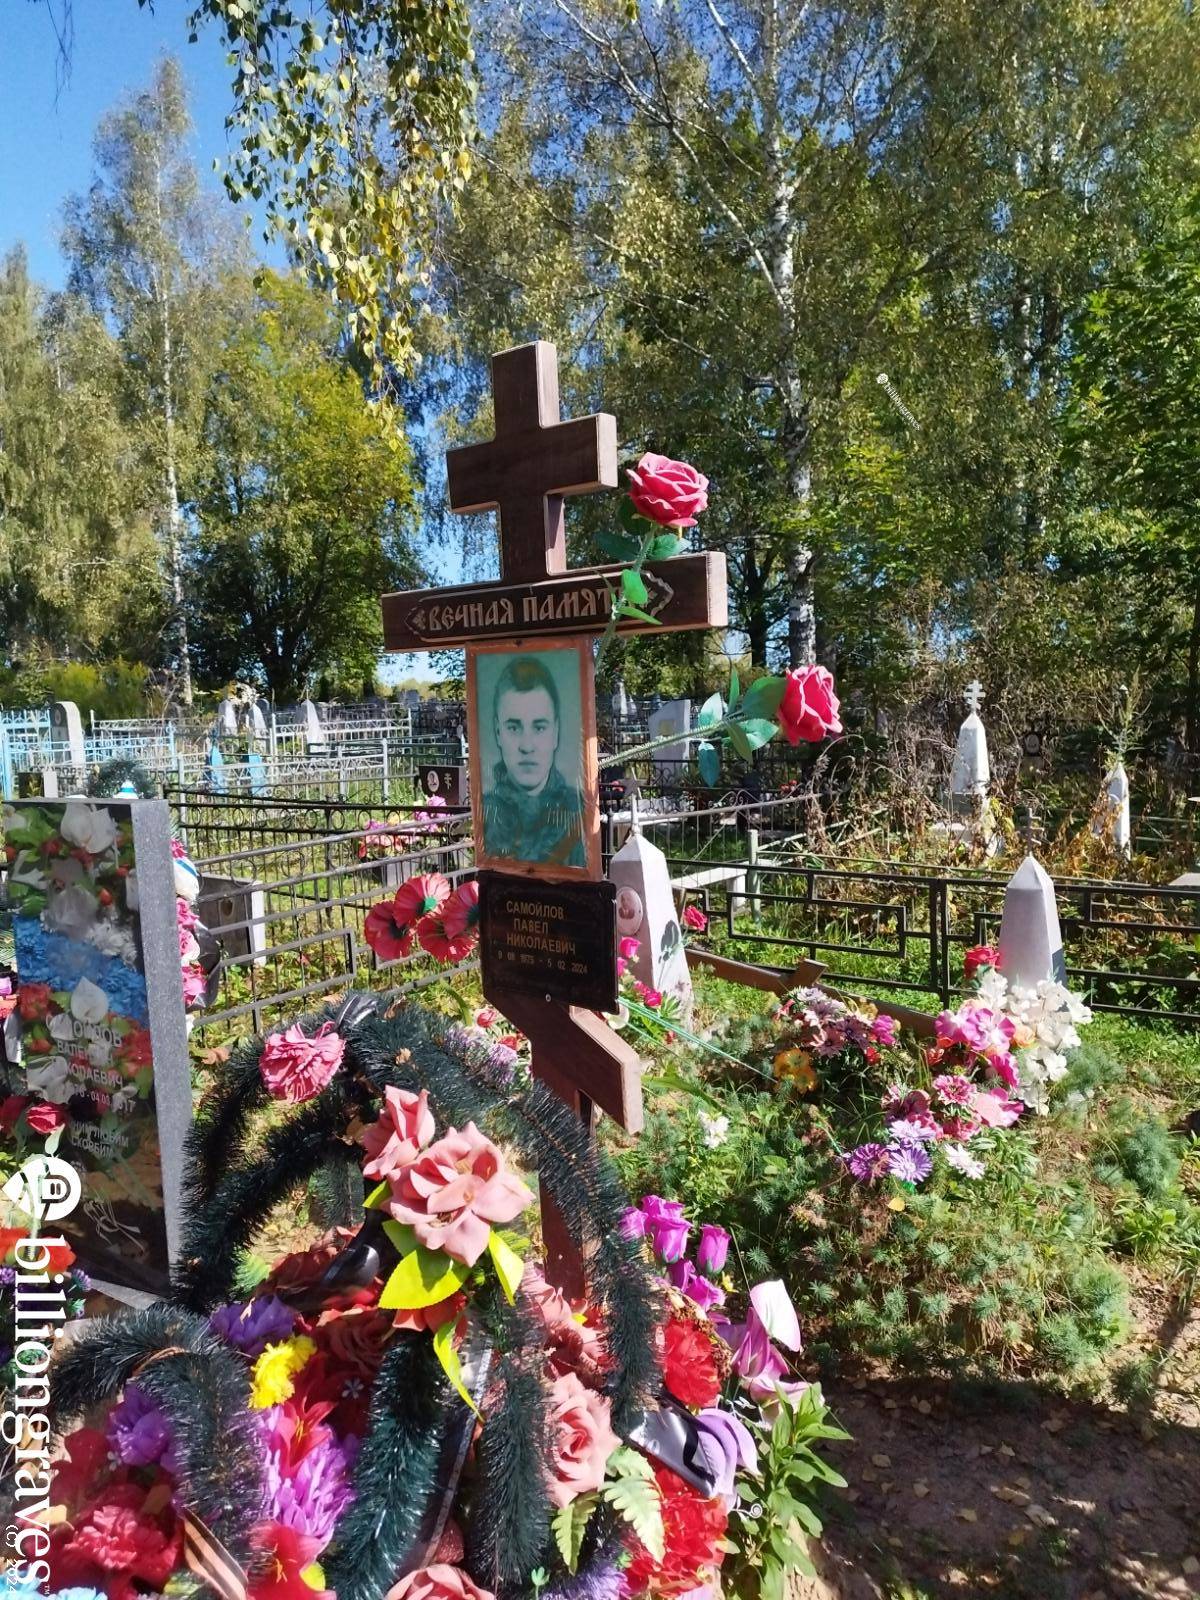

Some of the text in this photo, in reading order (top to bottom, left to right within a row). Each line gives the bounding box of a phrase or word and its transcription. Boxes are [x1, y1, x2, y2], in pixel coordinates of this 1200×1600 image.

[428, 587, 634, 632] ВЕЧНАЯ ПАМЯТ
[506, 900, 564, 920] САМОЙЛОВ
[513, 918, 549, 935] ПАВЕЛ
[506, 932, 576, 955] НИКОЛАЕВИЧ
